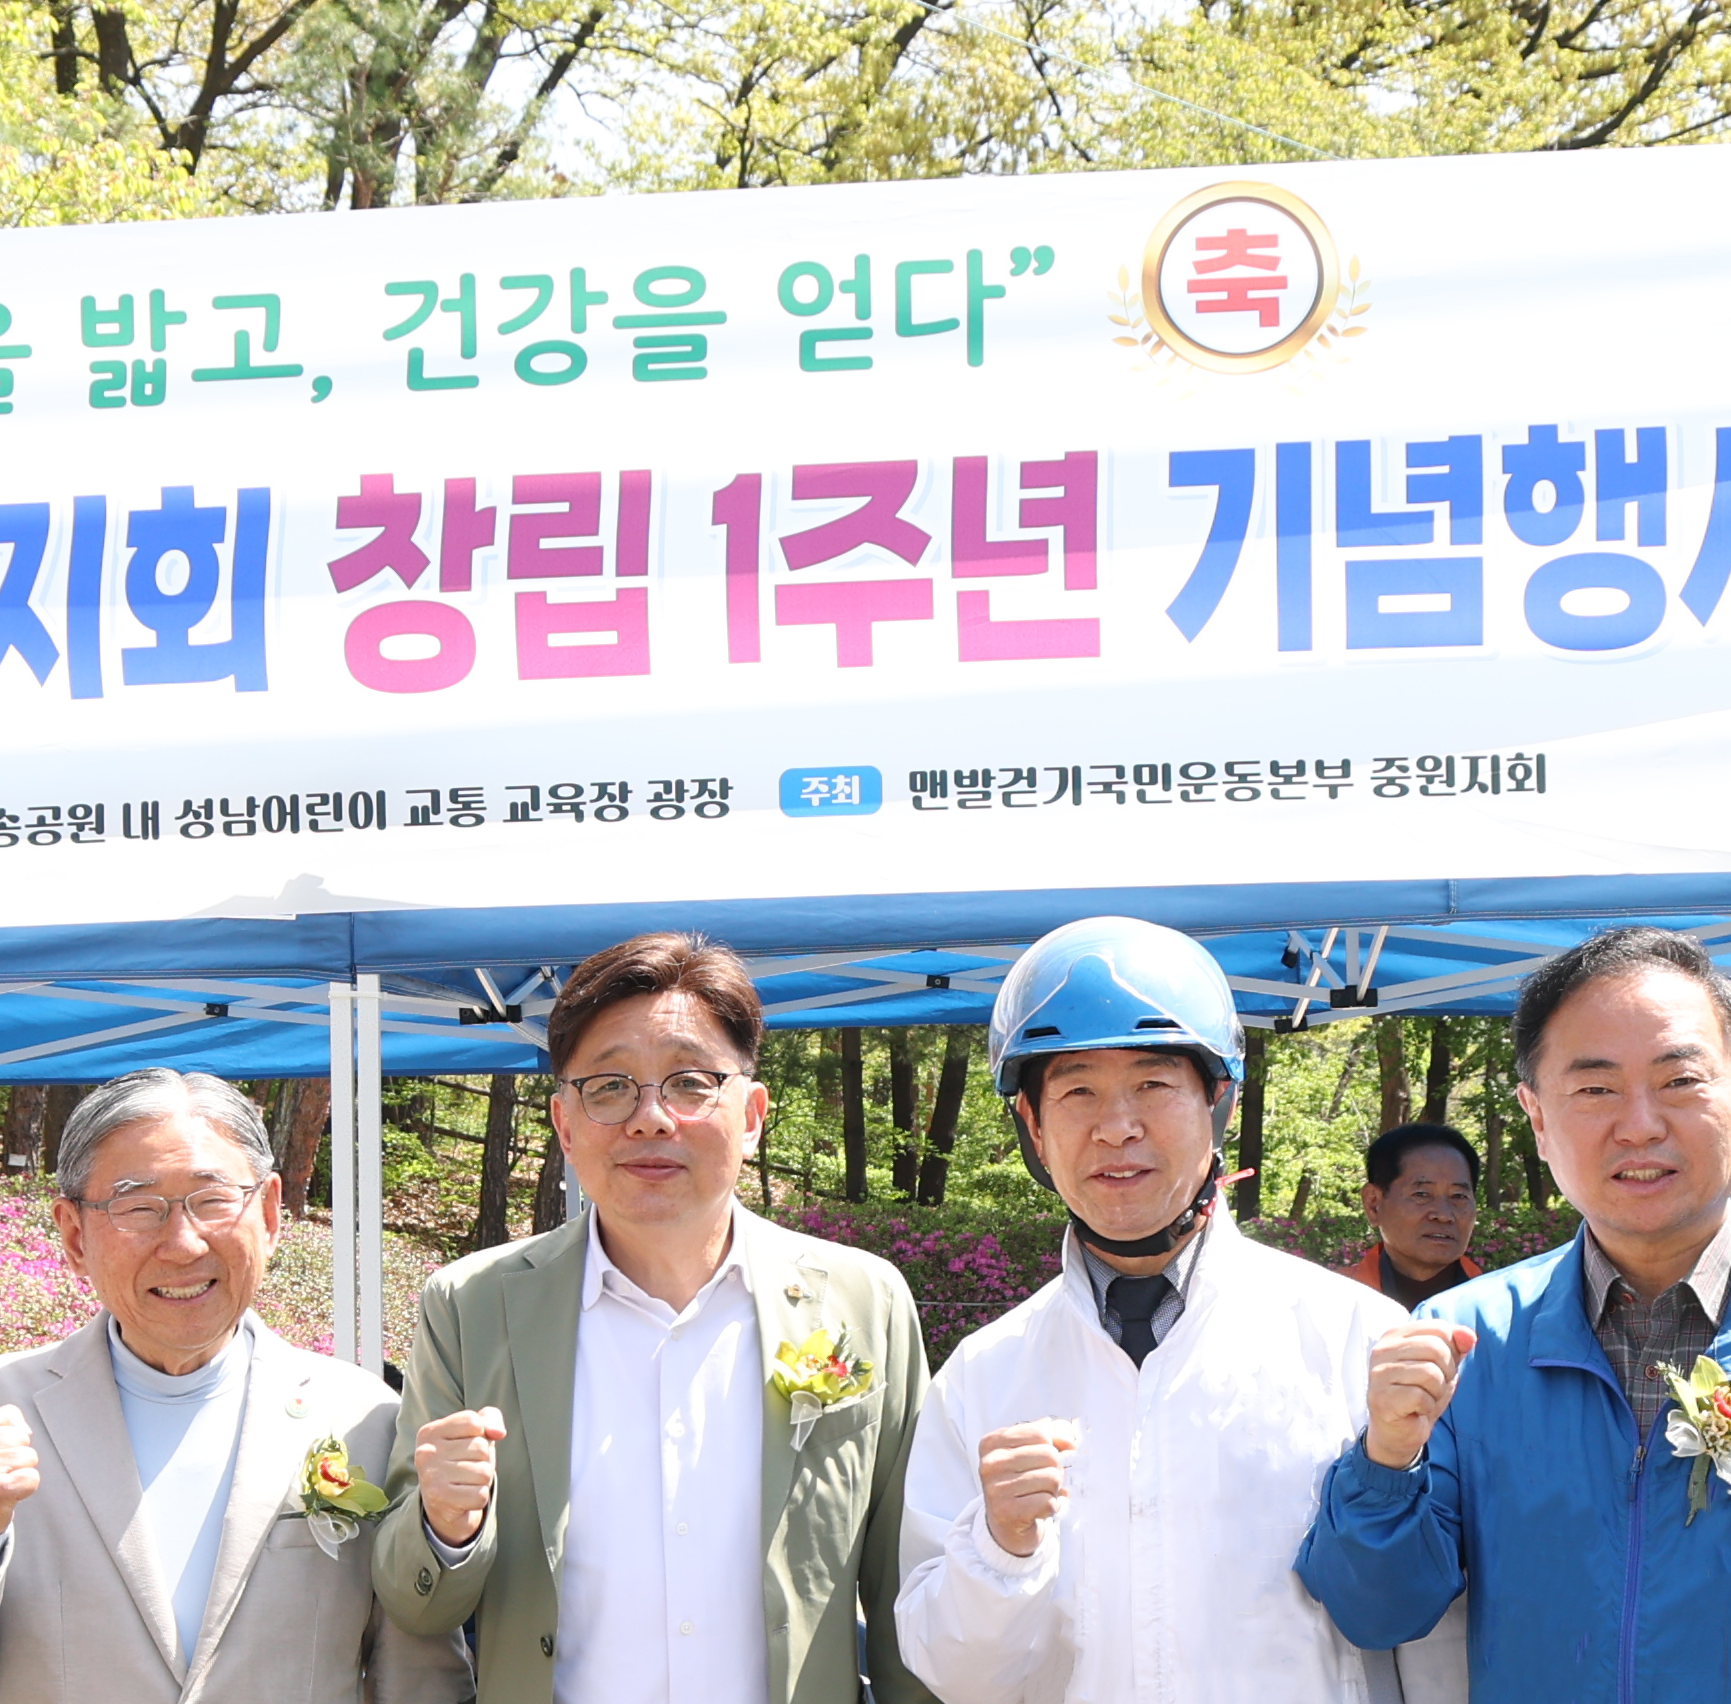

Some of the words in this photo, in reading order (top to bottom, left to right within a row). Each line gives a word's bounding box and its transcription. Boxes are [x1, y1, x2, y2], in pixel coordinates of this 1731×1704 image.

[1188, 229, 1292, 330] 축
[81, 287, 334, 410] 밟고,
[383, 265, 728, 392] 건강을
[778, 244, 1056, 374] 얻다”
[329, 469, 651, 694] 창립
[713, 450, 1101, 668] 1주년
[122, 800, 160, 841] 내
[174, 789, 387, 839] 성남어린이
[403, 786, 488, 828] 교통
[502, 780, 633, 823] 교육장
[646, 777, 734, 821] 광장
[800, 774, 861, 807] 주최
[909, 758, 1354, 811] 맨발걷기국민운동본부
[1370, 752, 1546, 798] 중원지회
